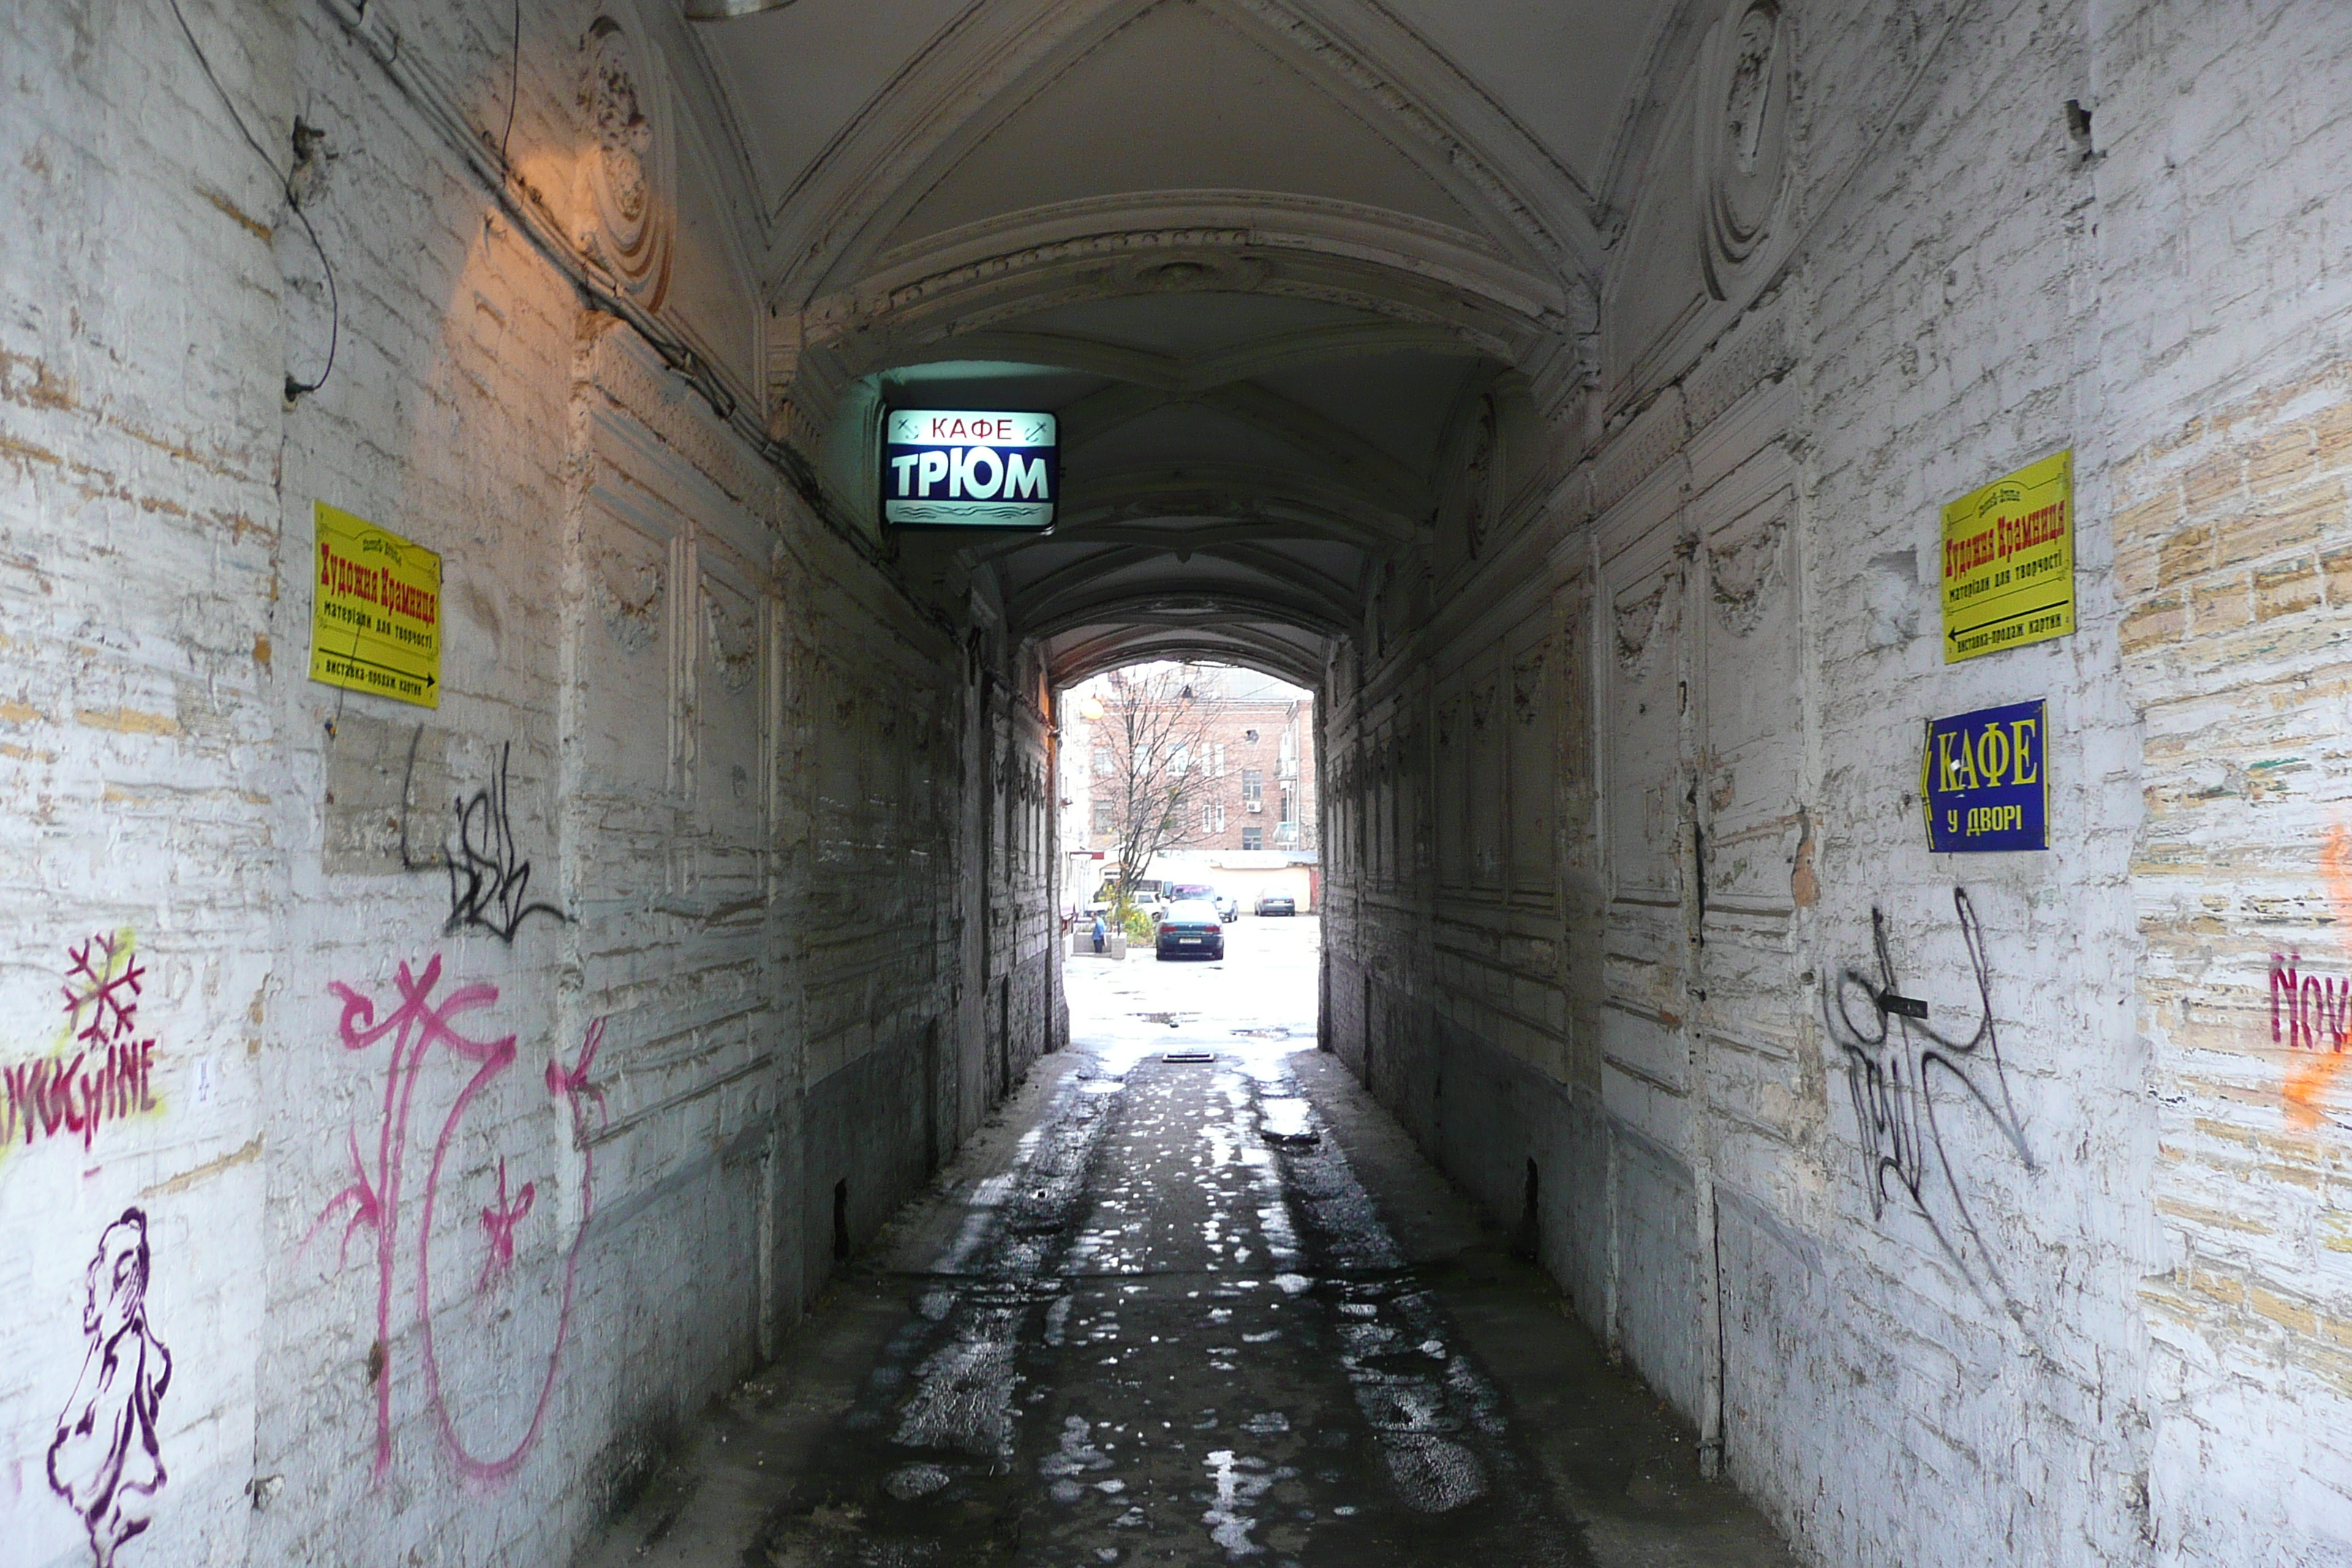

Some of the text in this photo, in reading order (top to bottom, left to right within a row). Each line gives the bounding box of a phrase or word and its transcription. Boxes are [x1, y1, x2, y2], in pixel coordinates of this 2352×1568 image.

[932, 418, 1013, 440] КАФЕ
[892, 445, 1049, 500] ТРЮМ
[1948, 549, 2062, 603] матеріали для творчості
[375, 618, 391, 636] для
[395, 624, 432, 649] творчості
[2028, 613, 2062, 635] картин
[1937, 718, 2038, 792] КАФЕ
[1948, 804, 2022, 837] У ДВОРІ
